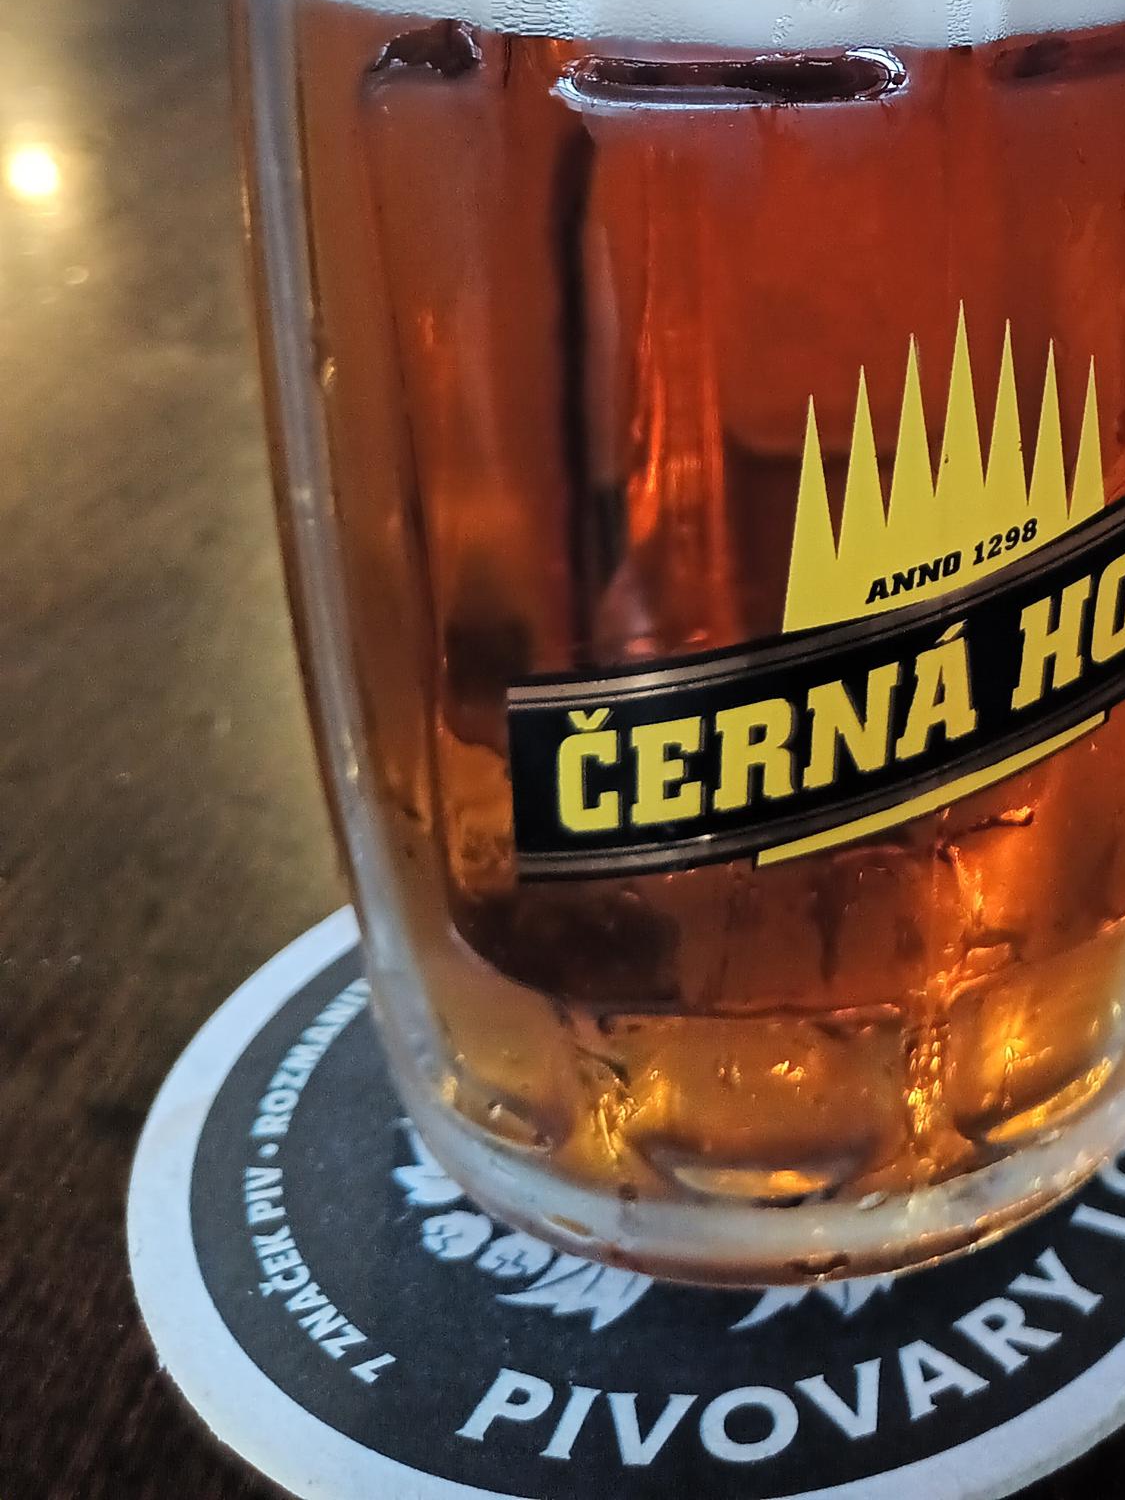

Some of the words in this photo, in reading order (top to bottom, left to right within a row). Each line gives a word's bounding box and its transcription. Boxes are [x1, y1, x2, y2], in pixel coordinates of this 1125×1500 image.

[864, 550, 962, 605] ANNO
[972, 517, 1039, 567] 1298
[556, 619, 978, 835] ČERNÁ
[244, 1166, 287, 1225] PIV
[252, 1225, 369, 1360] ZNAČEK
[454, 1246, 1104, 1466] PIVOVARY
